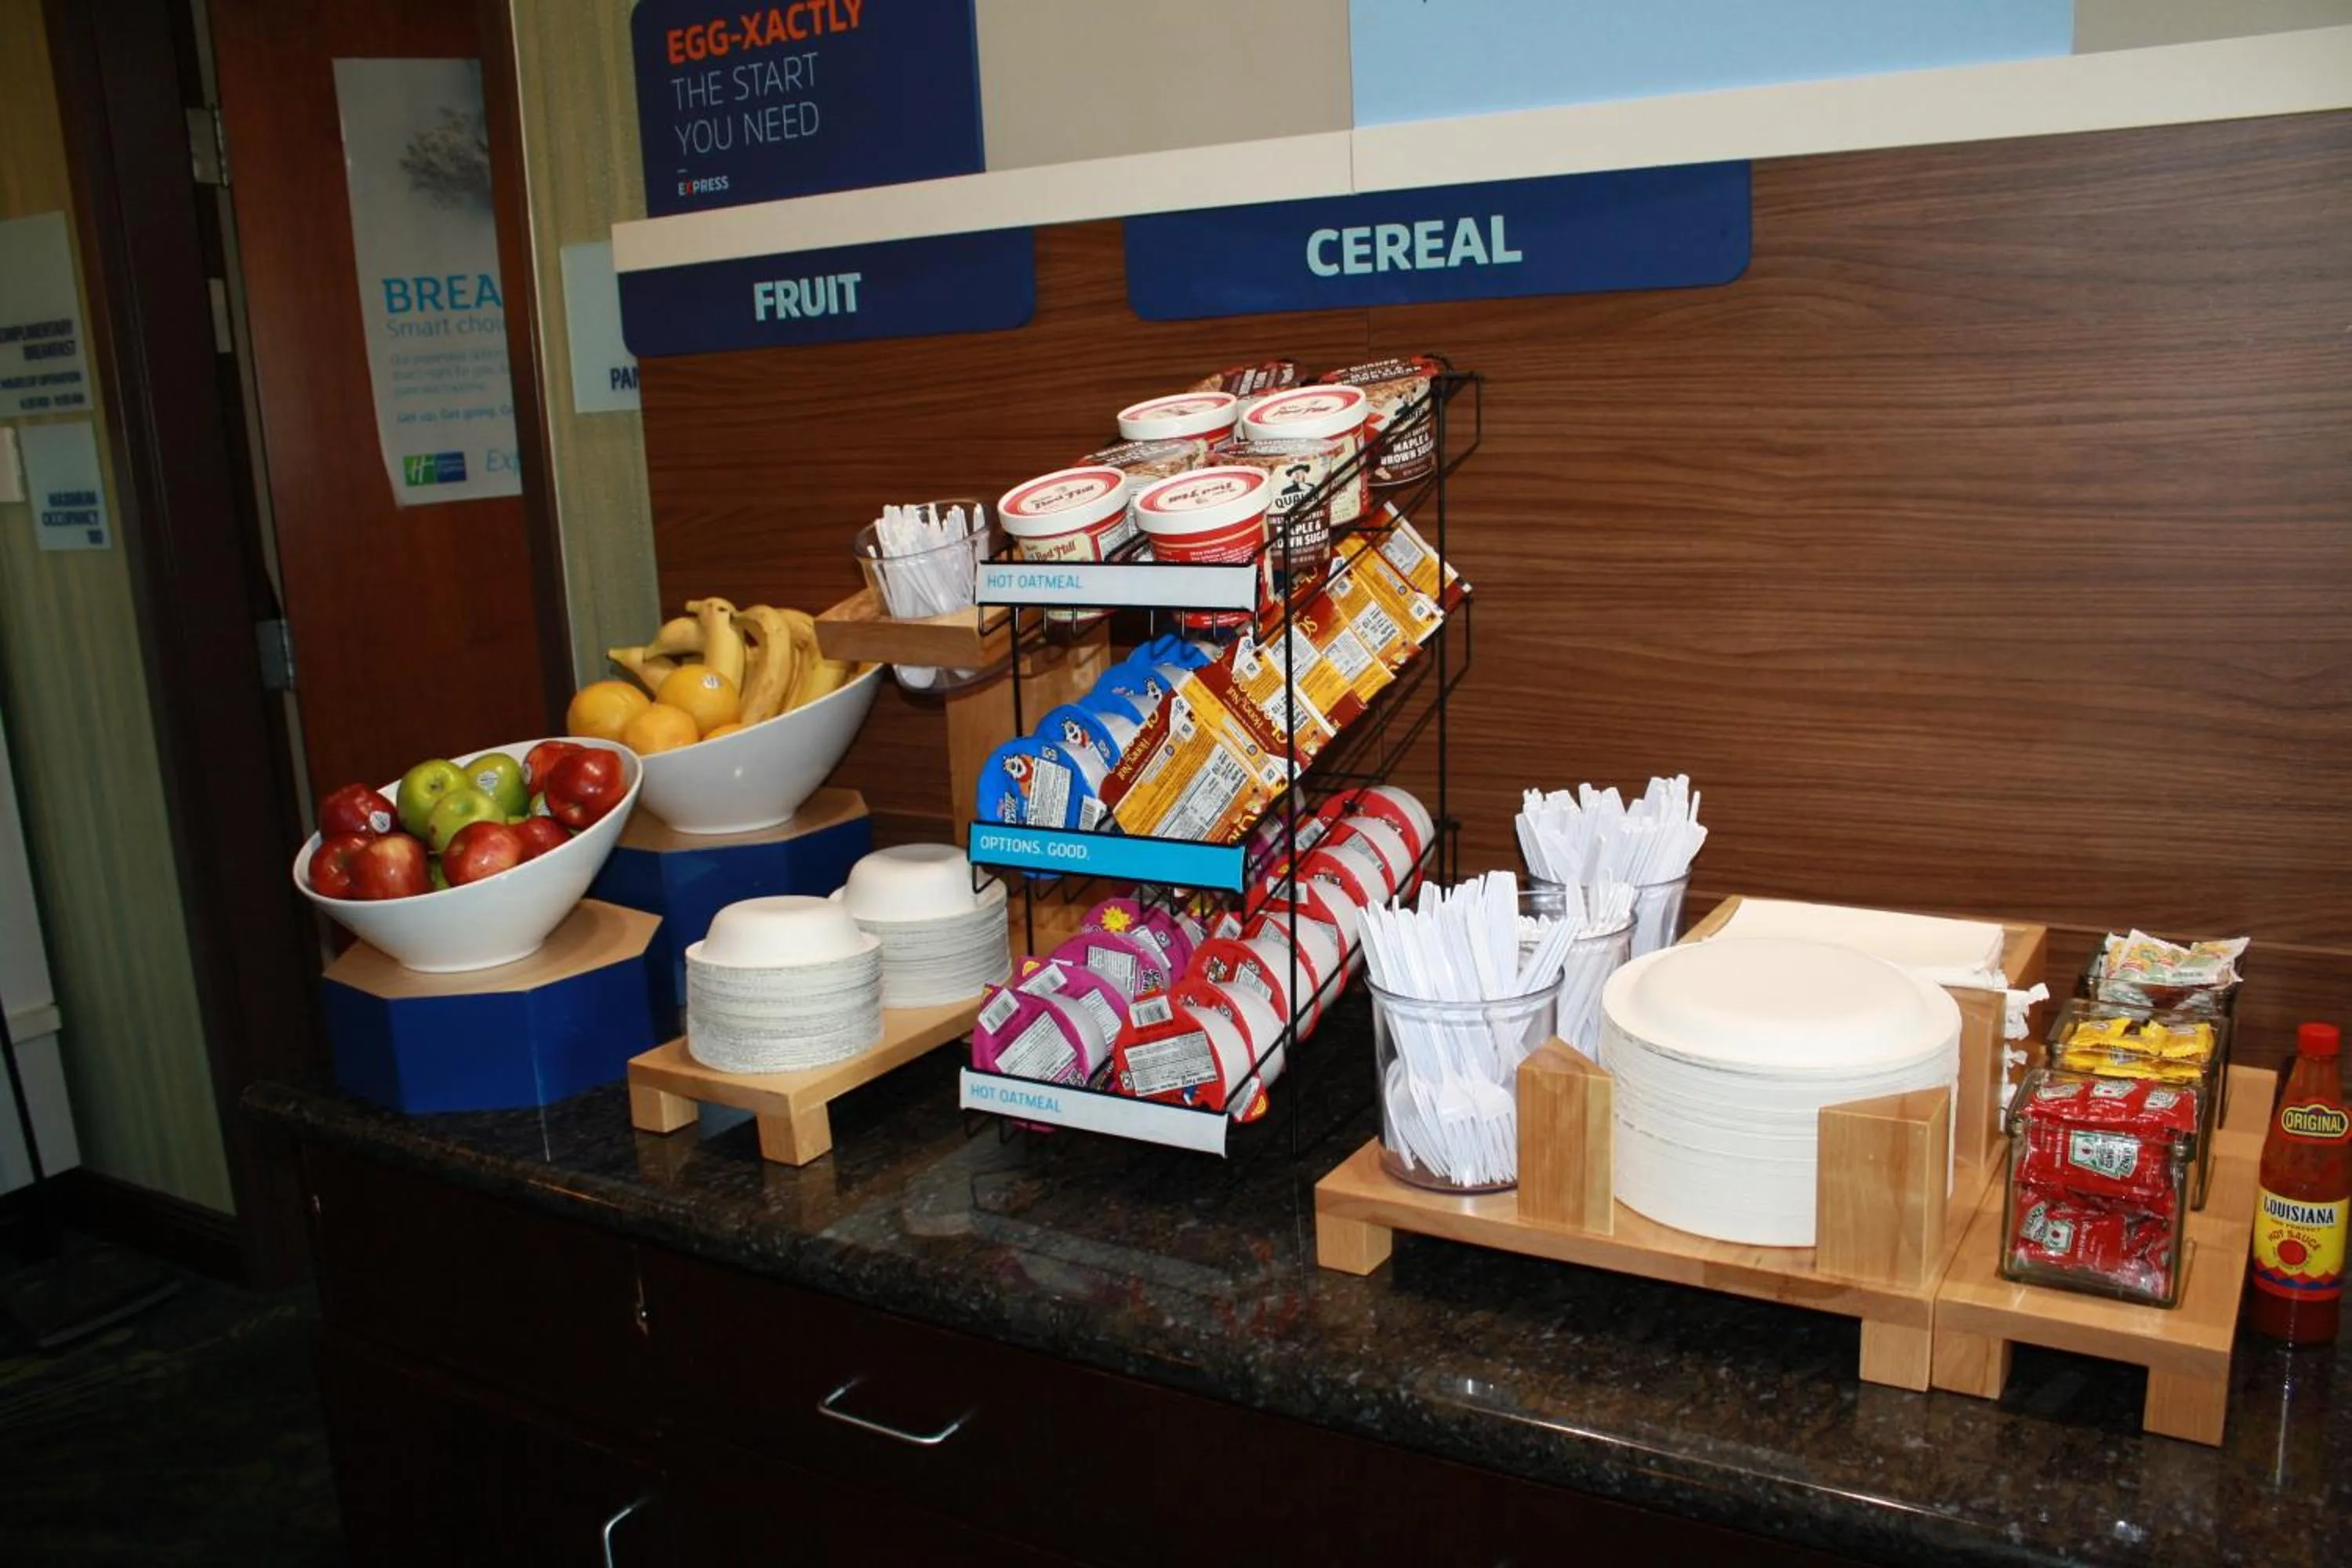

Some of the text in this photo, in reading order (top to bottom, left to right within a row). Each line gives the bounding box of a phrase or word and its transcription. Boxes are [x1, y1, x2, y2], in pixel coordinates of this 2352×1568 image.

[666, 0, 862, 64] EGG-XACTLY
[671, 52, 818, 111] THE START
[674, 101, 820, 156] YOU NEED
[677, 176, 729, 196] EXPRESS
[1306, 215, 1523, 277] CEREAL
[380, 274, 502, 314] BREA
[753, 272, 862, 321] FRUIT
[386, 318, 450, 339] Smart
[1393, 434, 1425, 452] MAPLE
[987, 574, 1083, 590] HOT OATMEAL
[980, 836, 1091, 861] OPTIONS. GOOD.
[971, 1083, 1062, 1112] HOT OATMEAL
[2285, 1112, 2343, 1132] ORIGINAL
[2264, 1196, 2335, 1225] LOUISIANA
